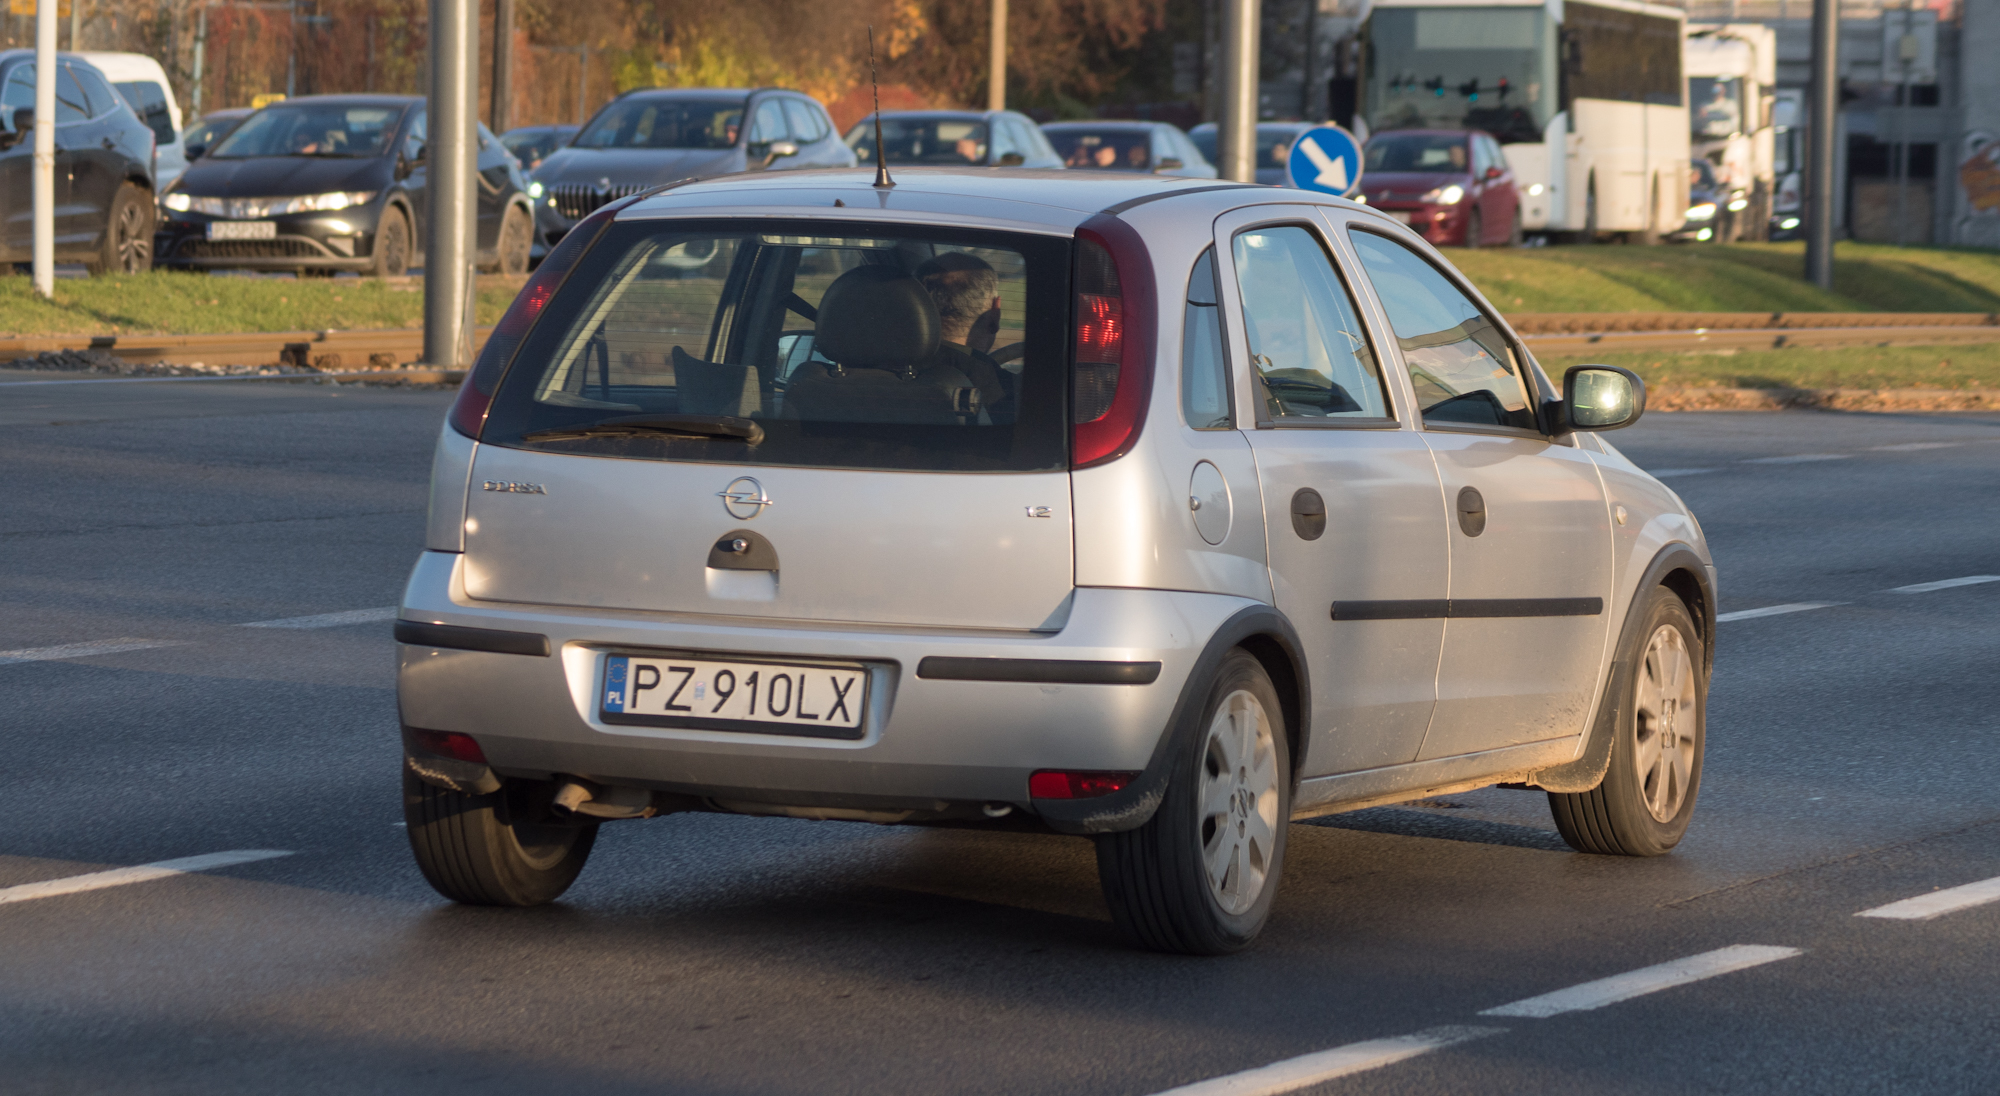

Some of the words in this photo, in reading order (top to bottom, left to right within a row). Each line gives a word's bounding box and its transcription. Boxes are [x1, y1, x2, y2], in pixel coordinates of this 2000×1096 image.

[483, 479, 548, 495] CORSA
[607, 691, 623, 704] PL
[631, 664, 696, 712] PZ
[711, 669, 855, 722] 910LX
